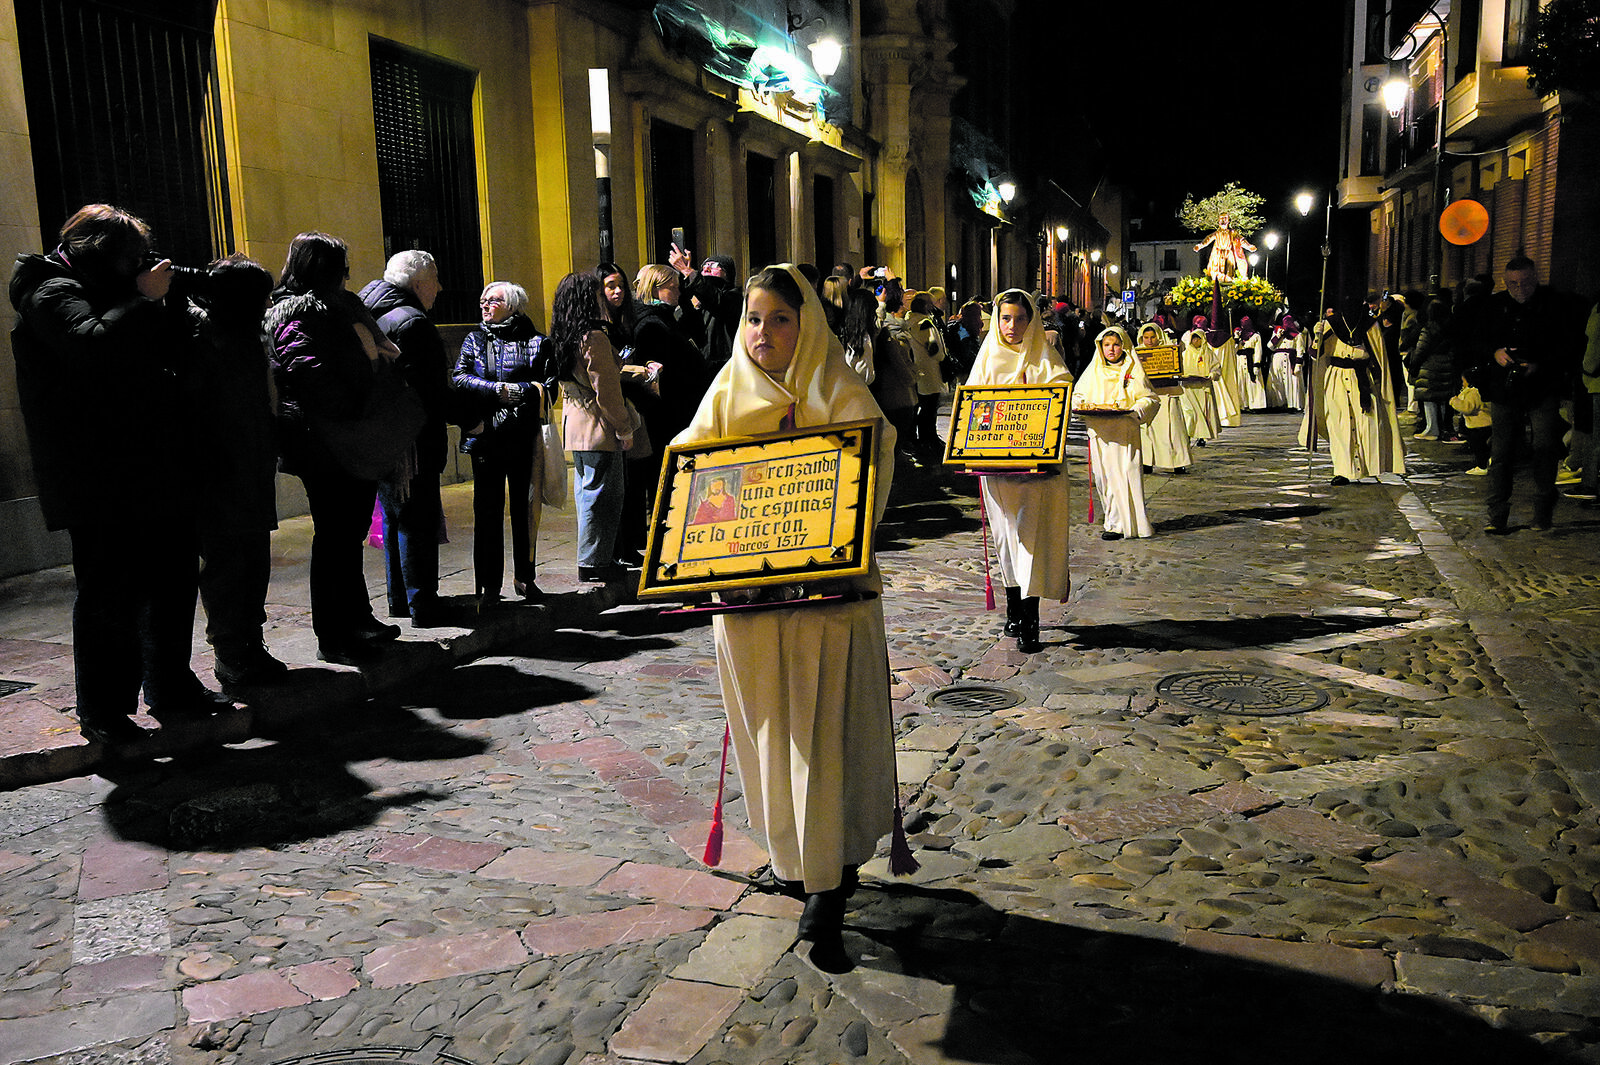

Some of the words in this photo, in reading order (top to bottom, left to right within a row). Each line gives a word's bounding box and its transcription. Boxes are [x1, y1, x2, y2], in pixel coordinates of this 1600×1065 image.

[1124, 292, 1132, 300] P
[996, 401, 1047, 412] Entonces
[995, 411, 1029, 424] Pilato
[968, 432, 1004, 444] azotar
[1008, 433, 1014, 441] a
[746, 456, 837, 484] Trenzando
[742, 486, 774, 501] una
[778, 478, 835, 497] corona
[740, 503, 758, 520] de
[762, 496, 833, 520] espinas
[686, 529, 706, 544] se
[709, 524, 725, 542] la
[733, 519, 808, 540] ciñeron.
[727, 540, 770, 555] Marcos
